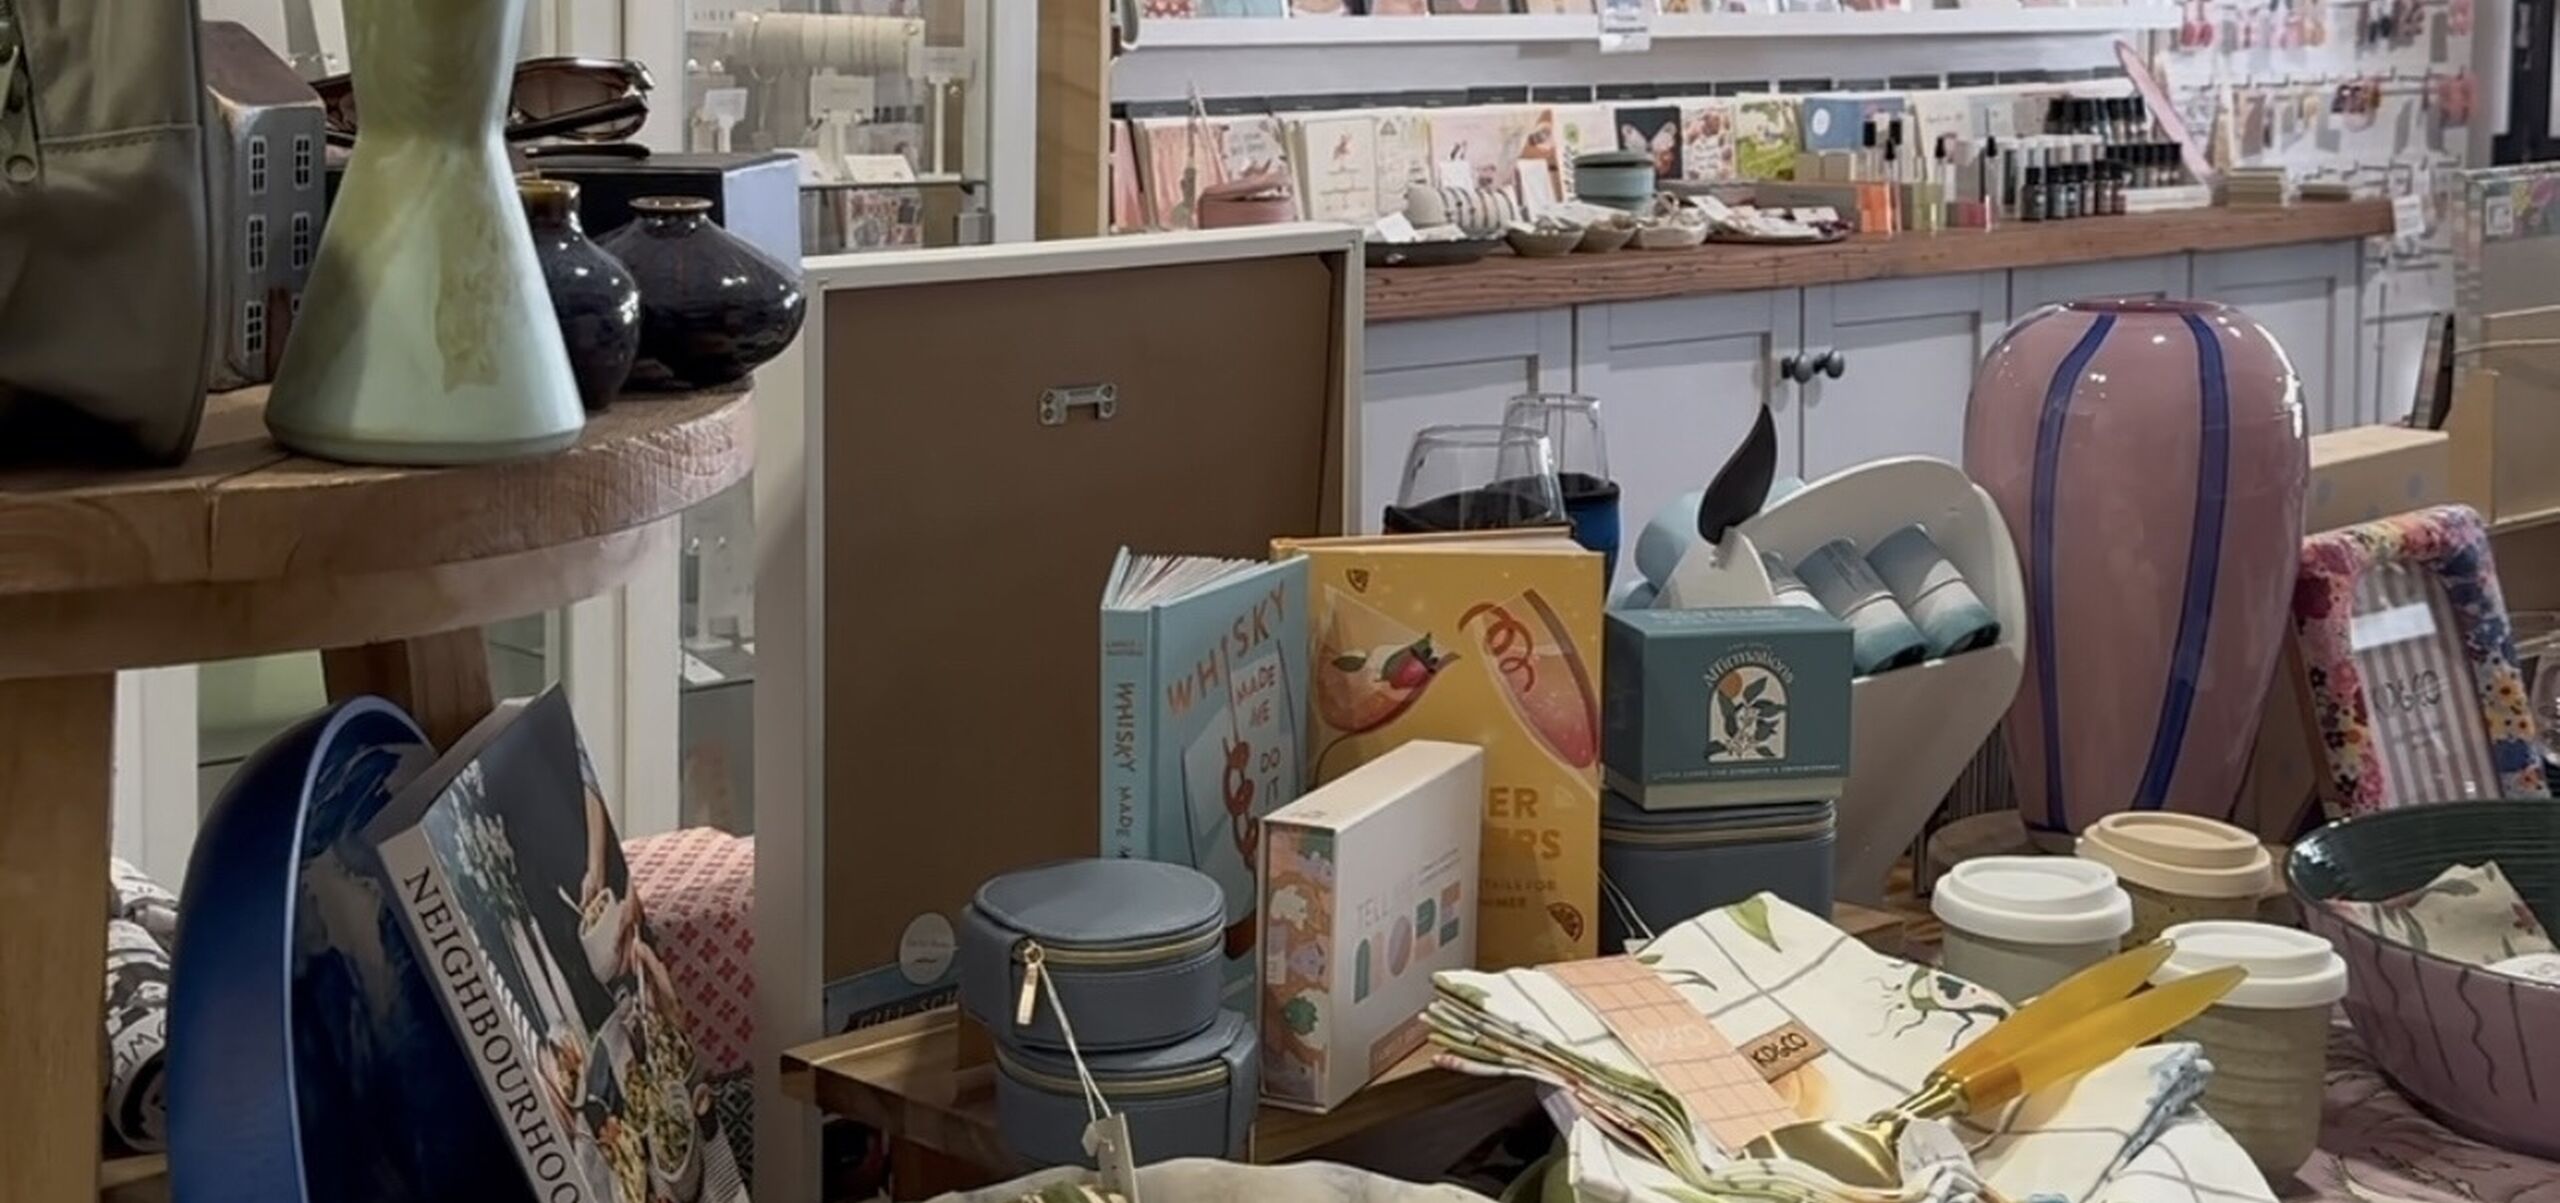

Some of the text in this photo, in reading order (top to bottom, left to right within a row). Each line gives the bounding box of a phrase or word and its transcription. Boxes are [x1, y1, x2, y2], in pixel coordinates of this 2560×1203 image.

[1167, 579, 1285, 721] WHISKY
[1703, 650, 1794, 687] Affirmations
[1236, 664, 1276, 705] MADE
[1113, 682, 1137, 773] WHISKY
[1259, 747, 1281, 773] DO
[1265, 776, 1279, 805] IT
[1115, 786, 1133, 838] MADE
